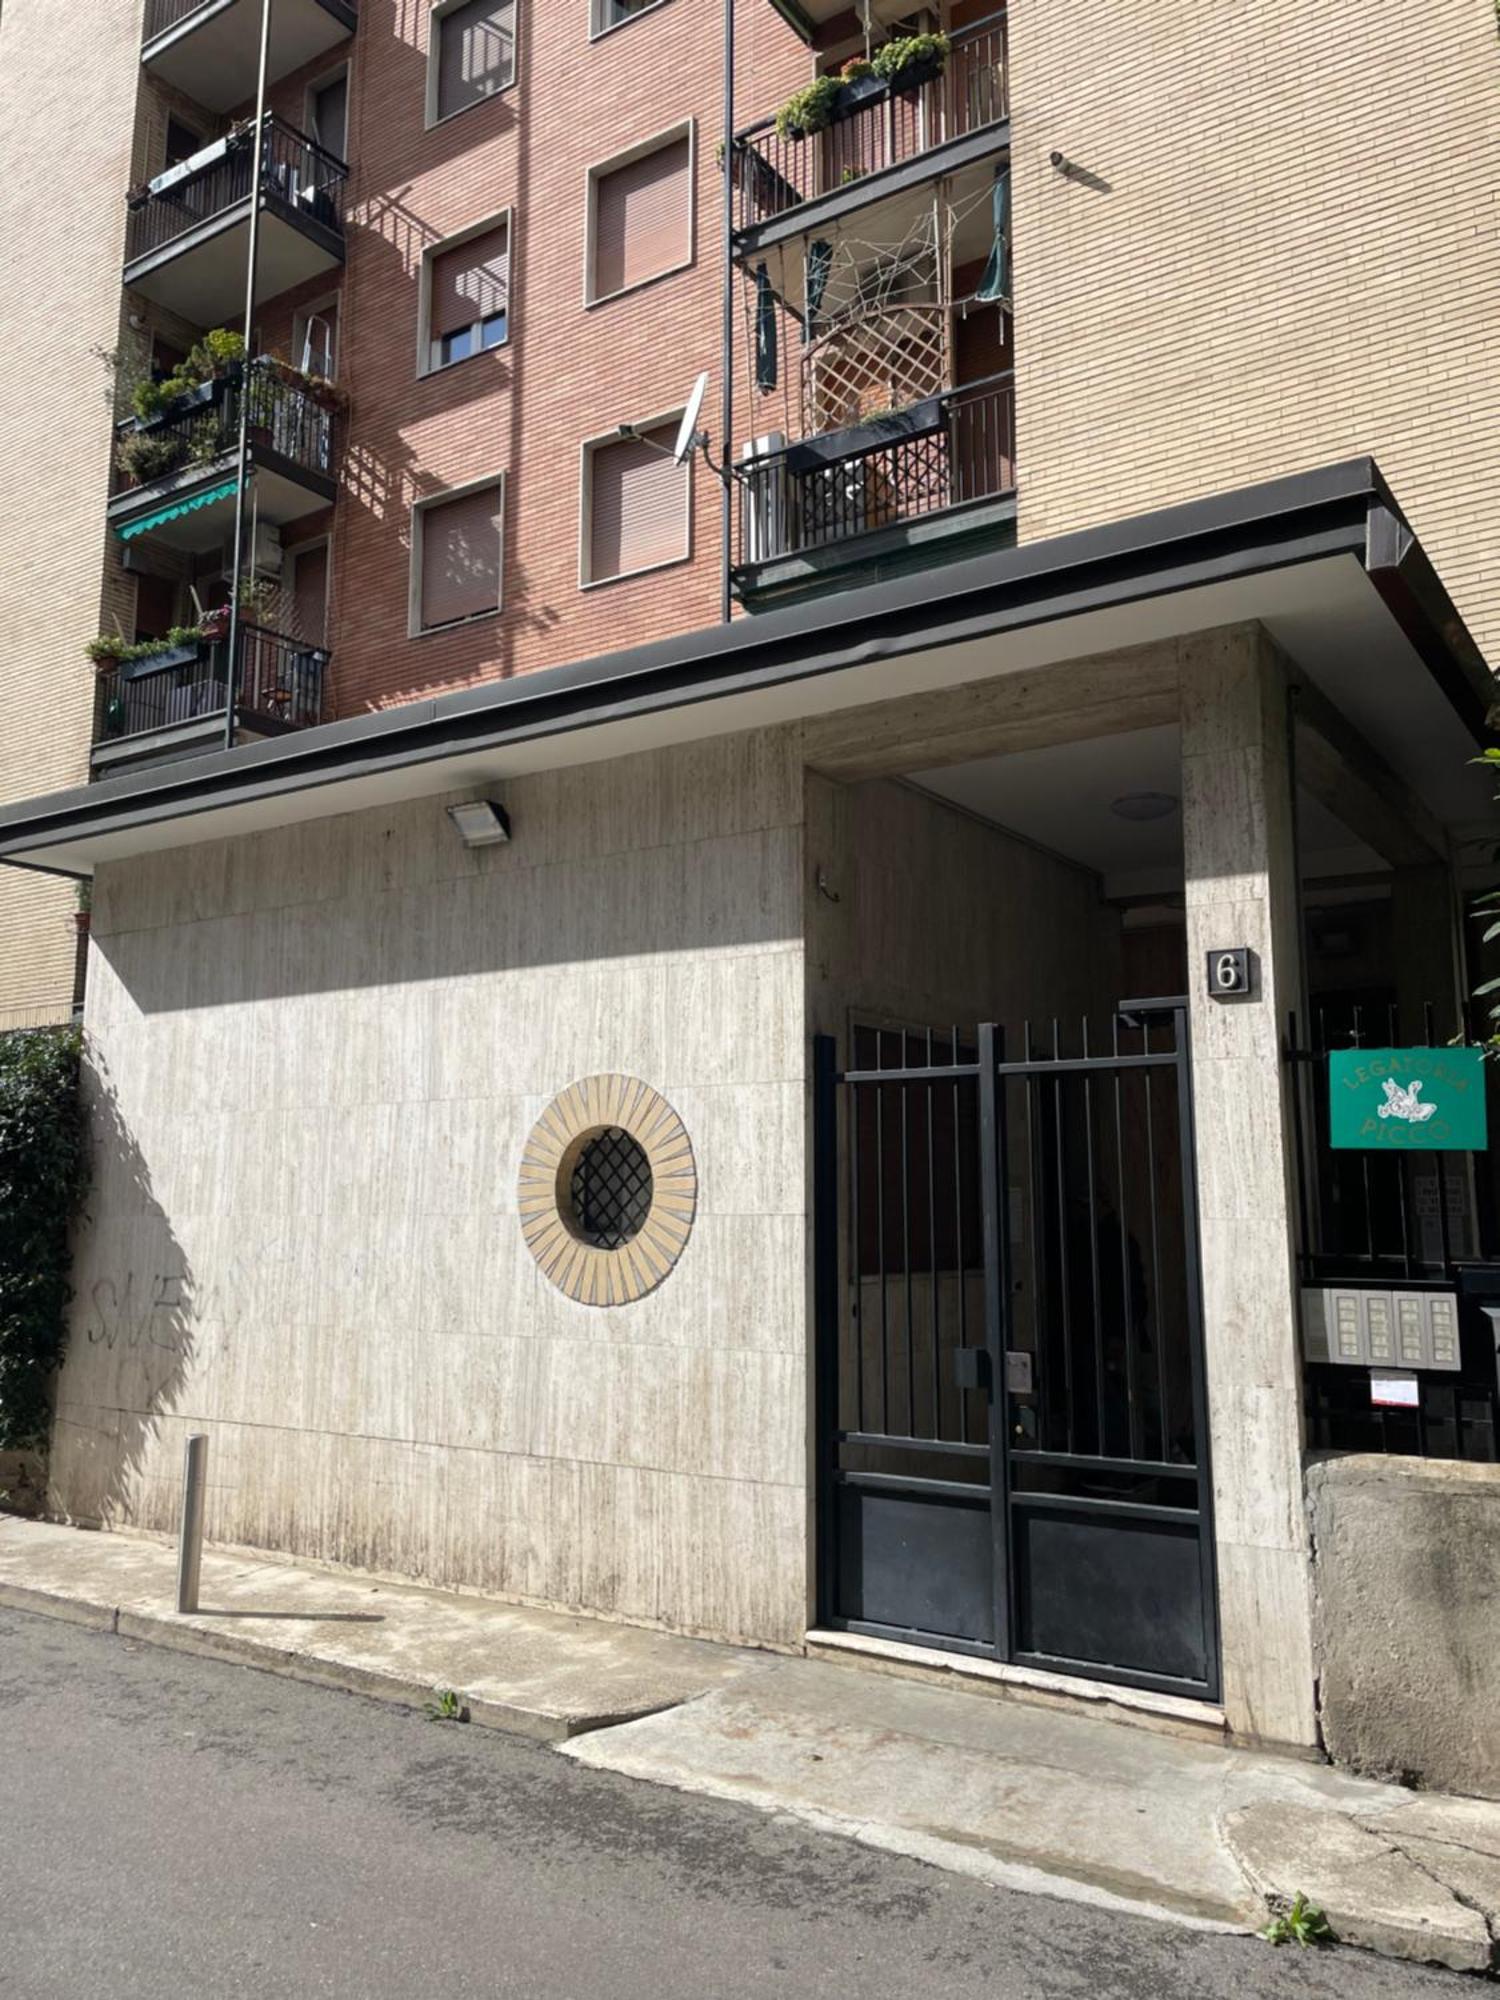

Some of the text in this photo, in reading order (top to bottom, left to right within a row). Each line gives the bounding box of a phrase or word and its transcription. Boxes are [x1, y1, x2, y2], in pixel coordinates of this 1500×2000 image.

[1216, 953, 1236, 988] 6
[1343, 1056, 1471, 1094] LEGATORIA
[1360, 1118, 1452, 1144] PICCO
